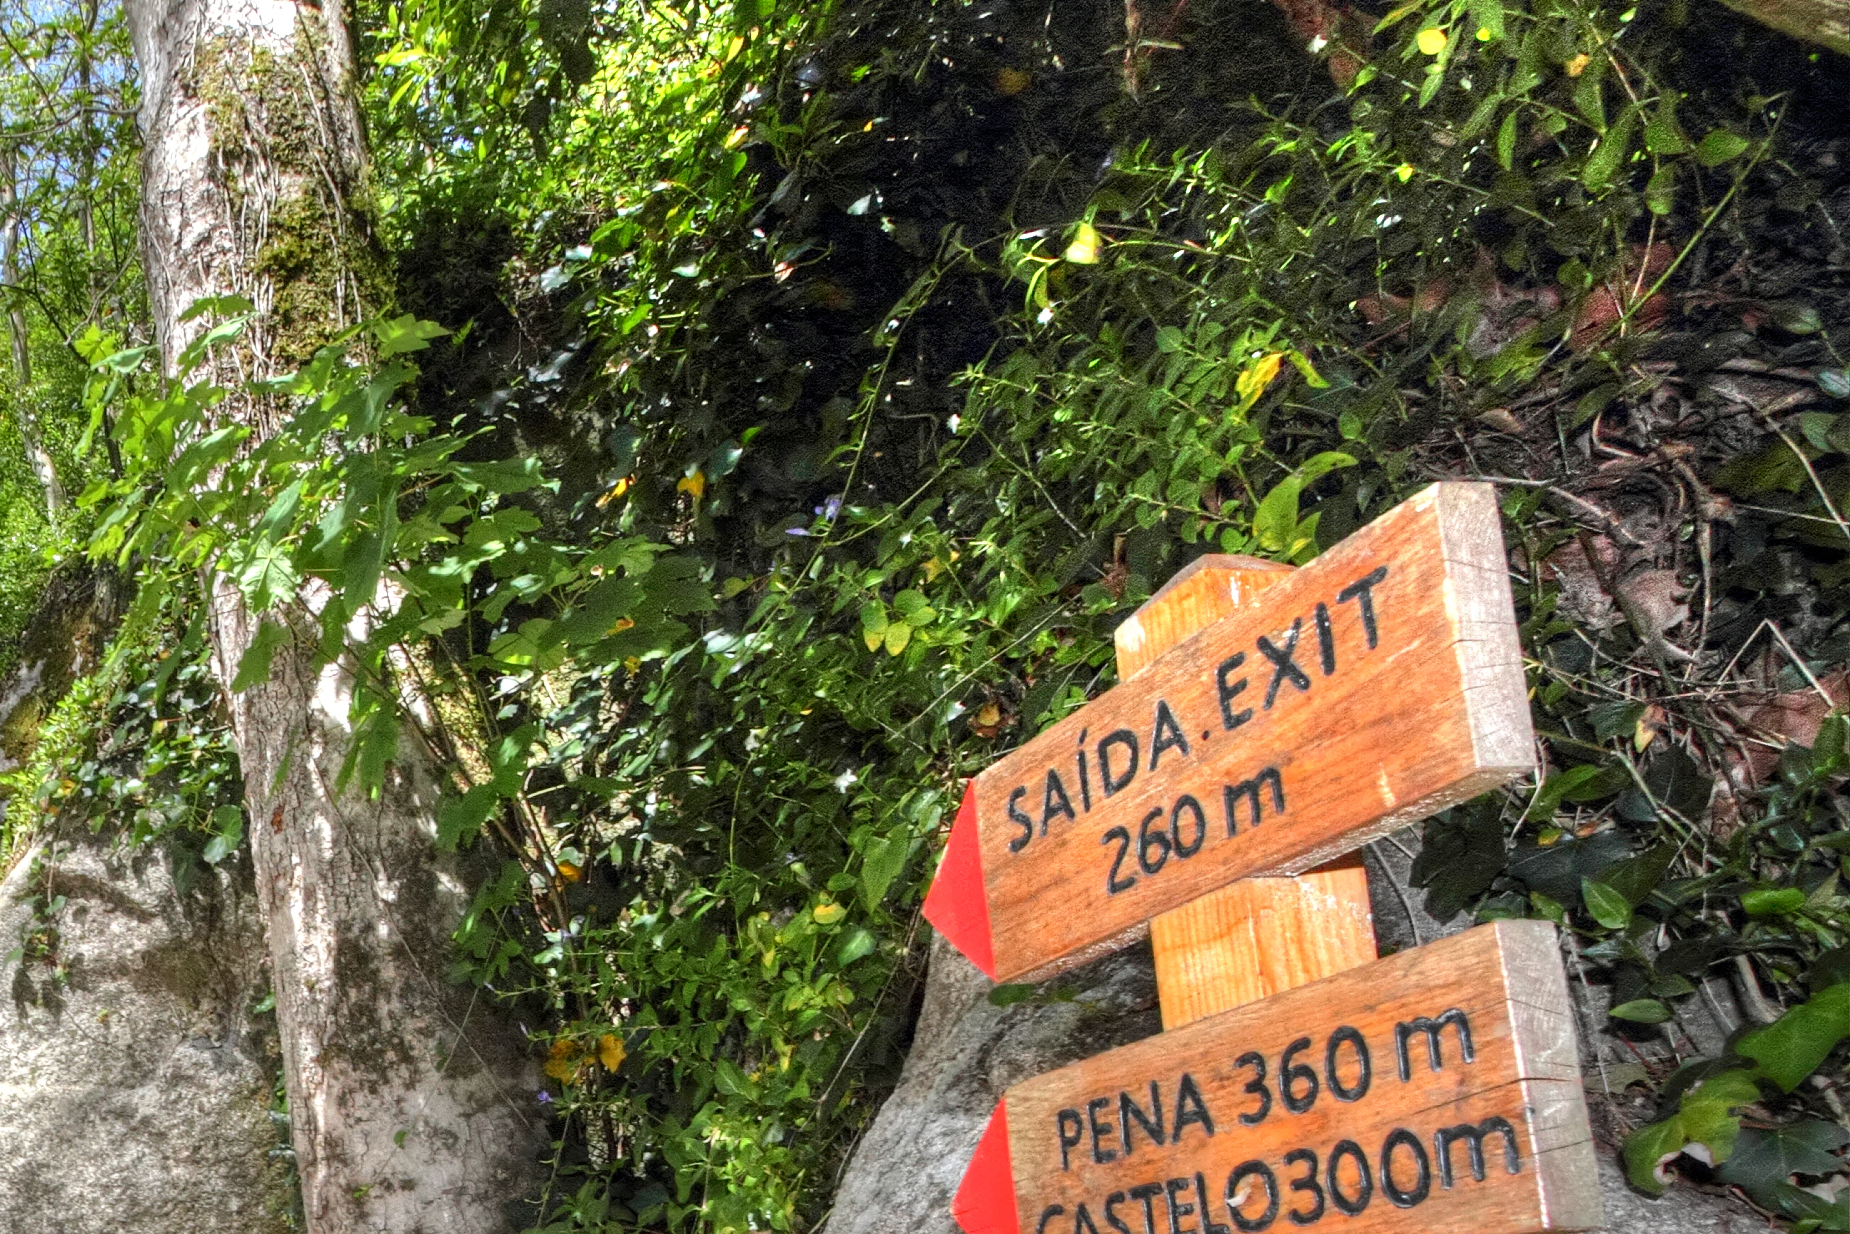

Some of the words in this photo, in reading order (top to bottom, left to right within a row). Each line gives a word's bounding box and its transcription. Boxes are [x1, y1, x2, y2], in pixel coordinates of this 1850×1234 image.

[1101, 795, 1206, 896] 260
[1057, 1072, 1215, 1171] PENA
[1234, 1024, 1372, 1126] 360
